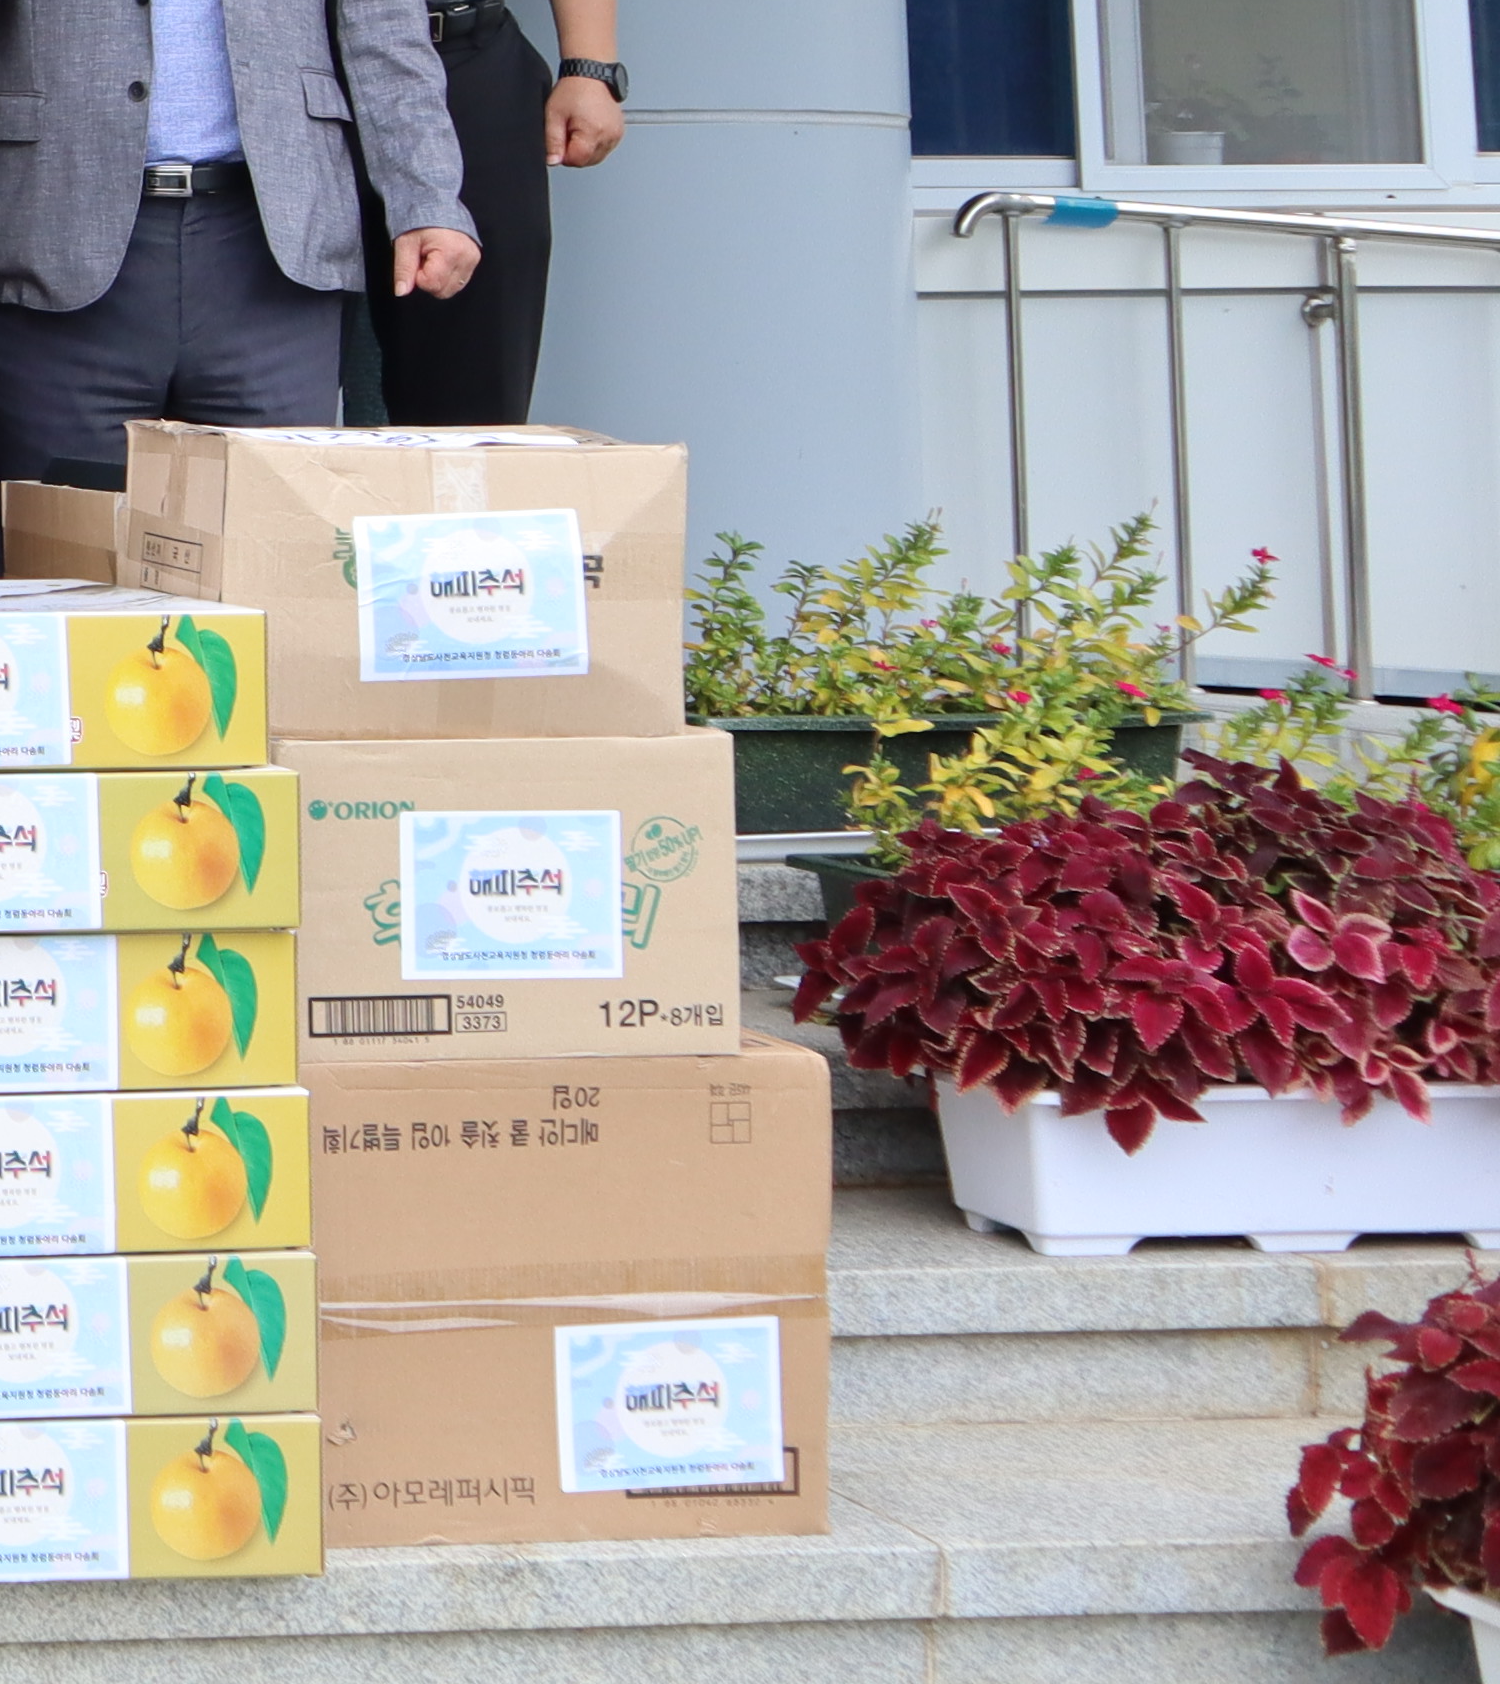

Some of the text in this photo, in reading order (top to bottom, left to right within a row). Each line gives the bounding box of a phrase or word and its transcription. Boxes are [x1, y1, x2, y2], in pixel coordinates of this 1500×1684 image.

[333, 801, 415, 820] ORION
[456, 994, 505, 1008] 54049
[462, 1015, 501, 1029] 3373
[552, 1085, 600, 1111] 20입
[323, 1122, 401, 1154] 특별기획
[411, 1122, 451, 1150] 10입
[461, 1120, 500, 1149] 칫솔
[539, 1119, 600, 1147] 메디안
